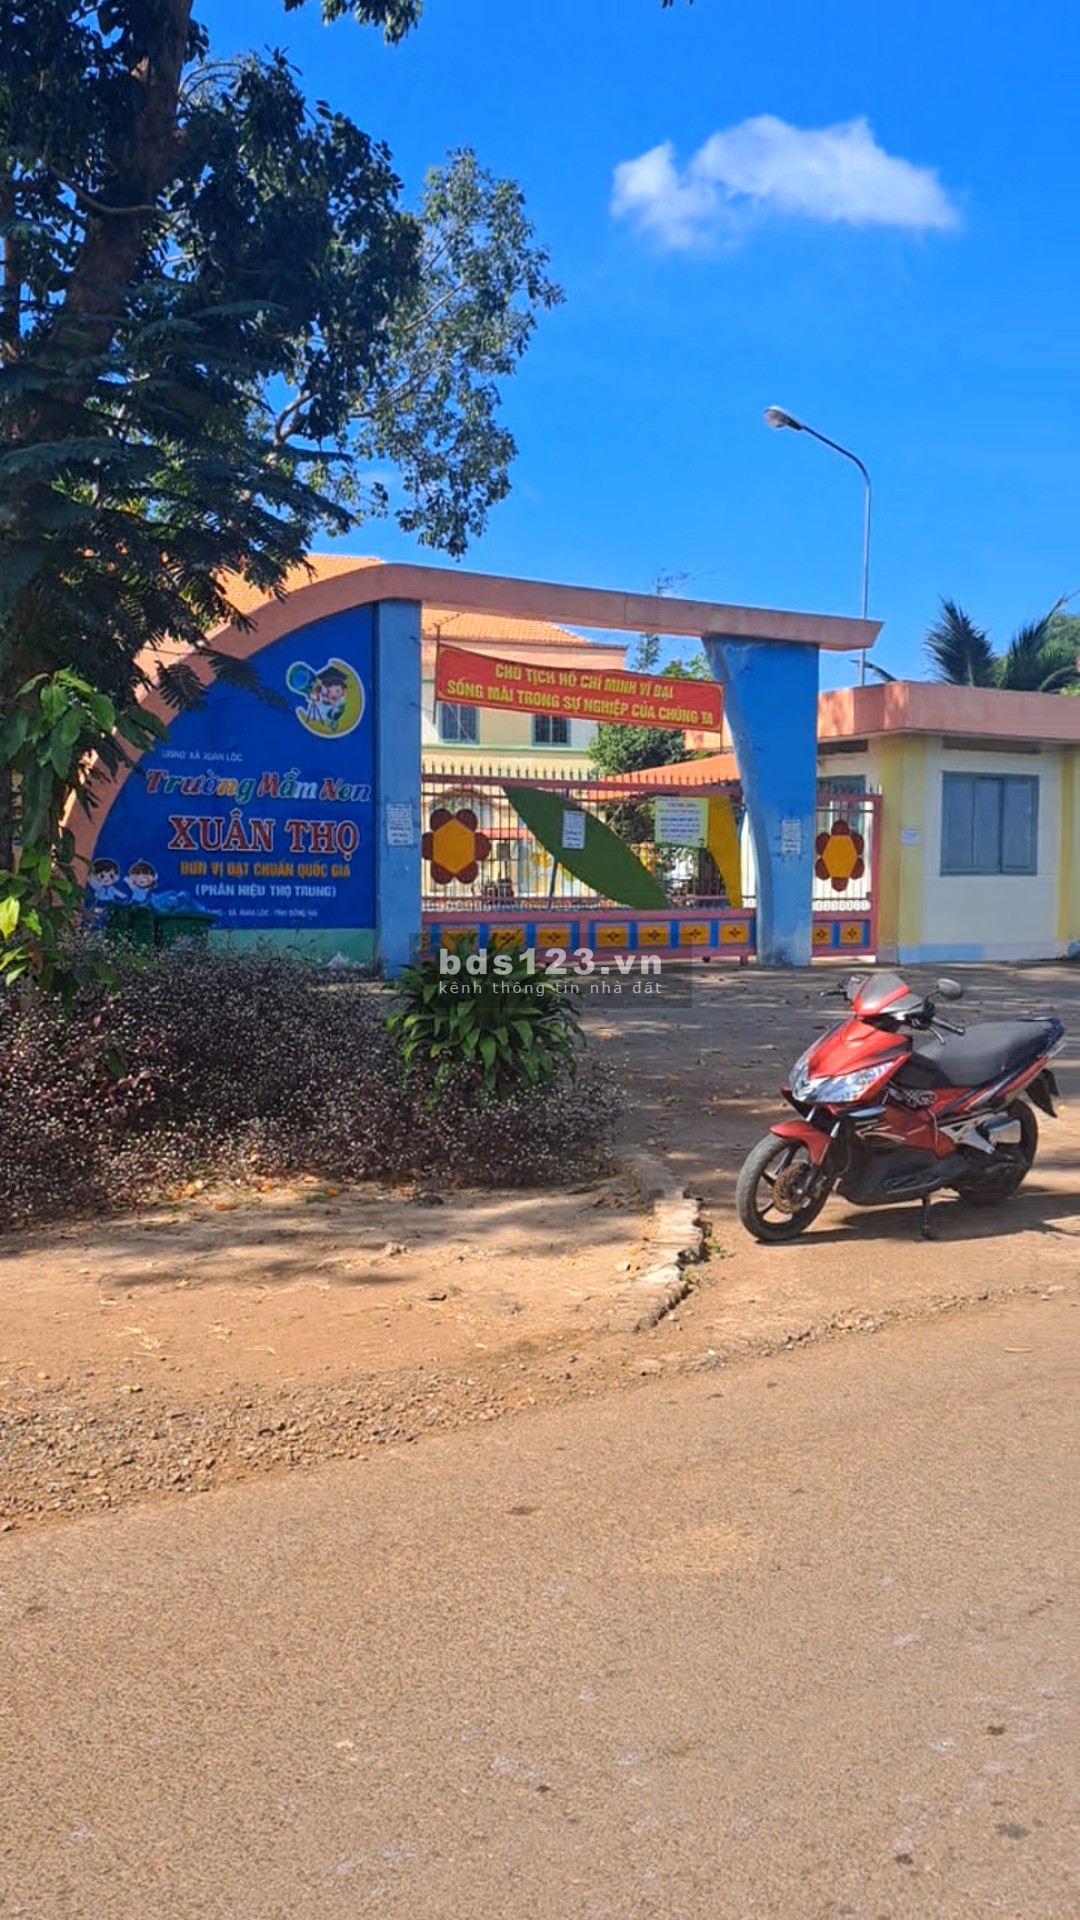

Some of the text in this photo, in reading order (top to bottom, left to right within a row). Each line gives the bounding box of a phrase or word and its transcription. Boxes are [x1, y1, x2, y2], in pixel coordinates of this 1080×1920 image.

[447, 677, 483, 699] SỐNG
[517, 689, 560, 708] TRONG
[563, 695, 582, 713] SỰ
[584, 698, 629, 717] NGHIỆP
[631, 701, 656, 719] CỦA
[658, 706, 698, 724] CHÚNG
[702, 711, 713, 726] TA
[525, 668, 555, 685] TỊCH
[559, 670, 576, 688] HỒ
[580, 673, 600, 690] CHÍ
[604, 678, 637, 695] MINH
[653, 683, 674, 701] ĐẠI
[146, 768, 371, 804] Trường Mầm Non
[168, 808, 276, 851] XUÂN
[284, 819, 360, 860] THỌ
[211, 861, 223, 878] VỊ
[227, 861, 249, 878] ĐẠT
[253, 859, 294, 877] CHUẨN
[297, 860, 328, 879] QUỐC
[331, 863, 351, 878] GIA
[195, 882, 337, 898] (PHÂN HIỆU THỌ TRUNG)
